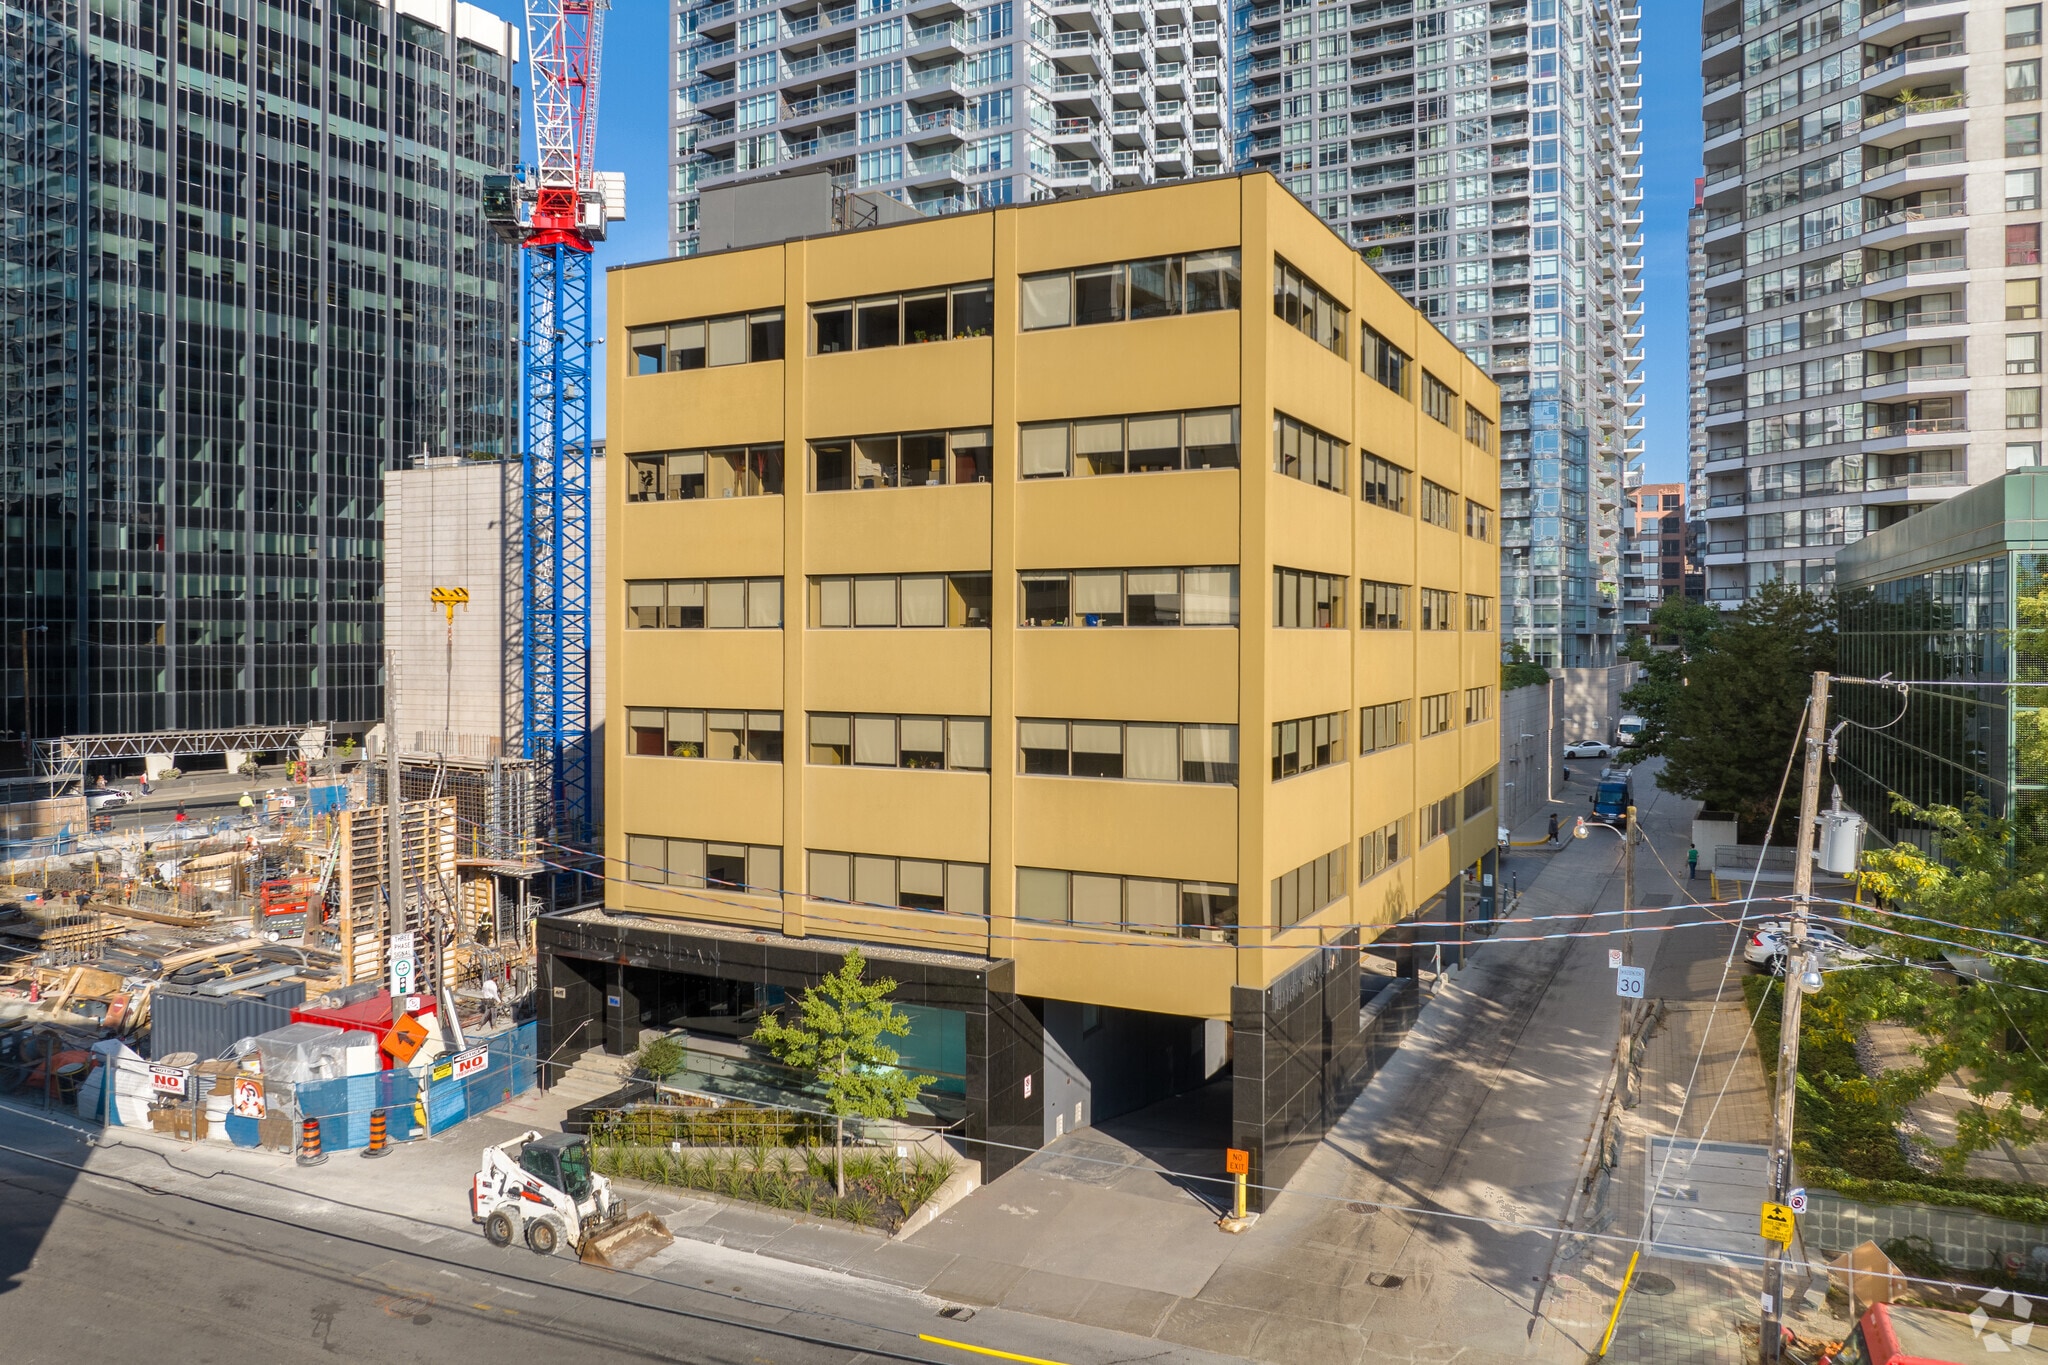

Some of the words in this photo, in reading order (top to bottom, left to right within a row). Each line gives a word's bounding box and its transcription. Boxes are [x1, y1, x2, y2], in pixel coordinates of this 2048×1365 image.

[394, 942, 411, 950] PHASE
[557, 931, 623, 953] THIRTY
[634, 940, 721, 967] SOUDAN
[1620, 979, 1641, 993] 30
[459, 1056, 483, 1072] NO
[155, 1075, 178, 1086] NO
[1232, 1153, 1243, 1161] NO
[1229, 1161, 1245, 1171] EXIT
